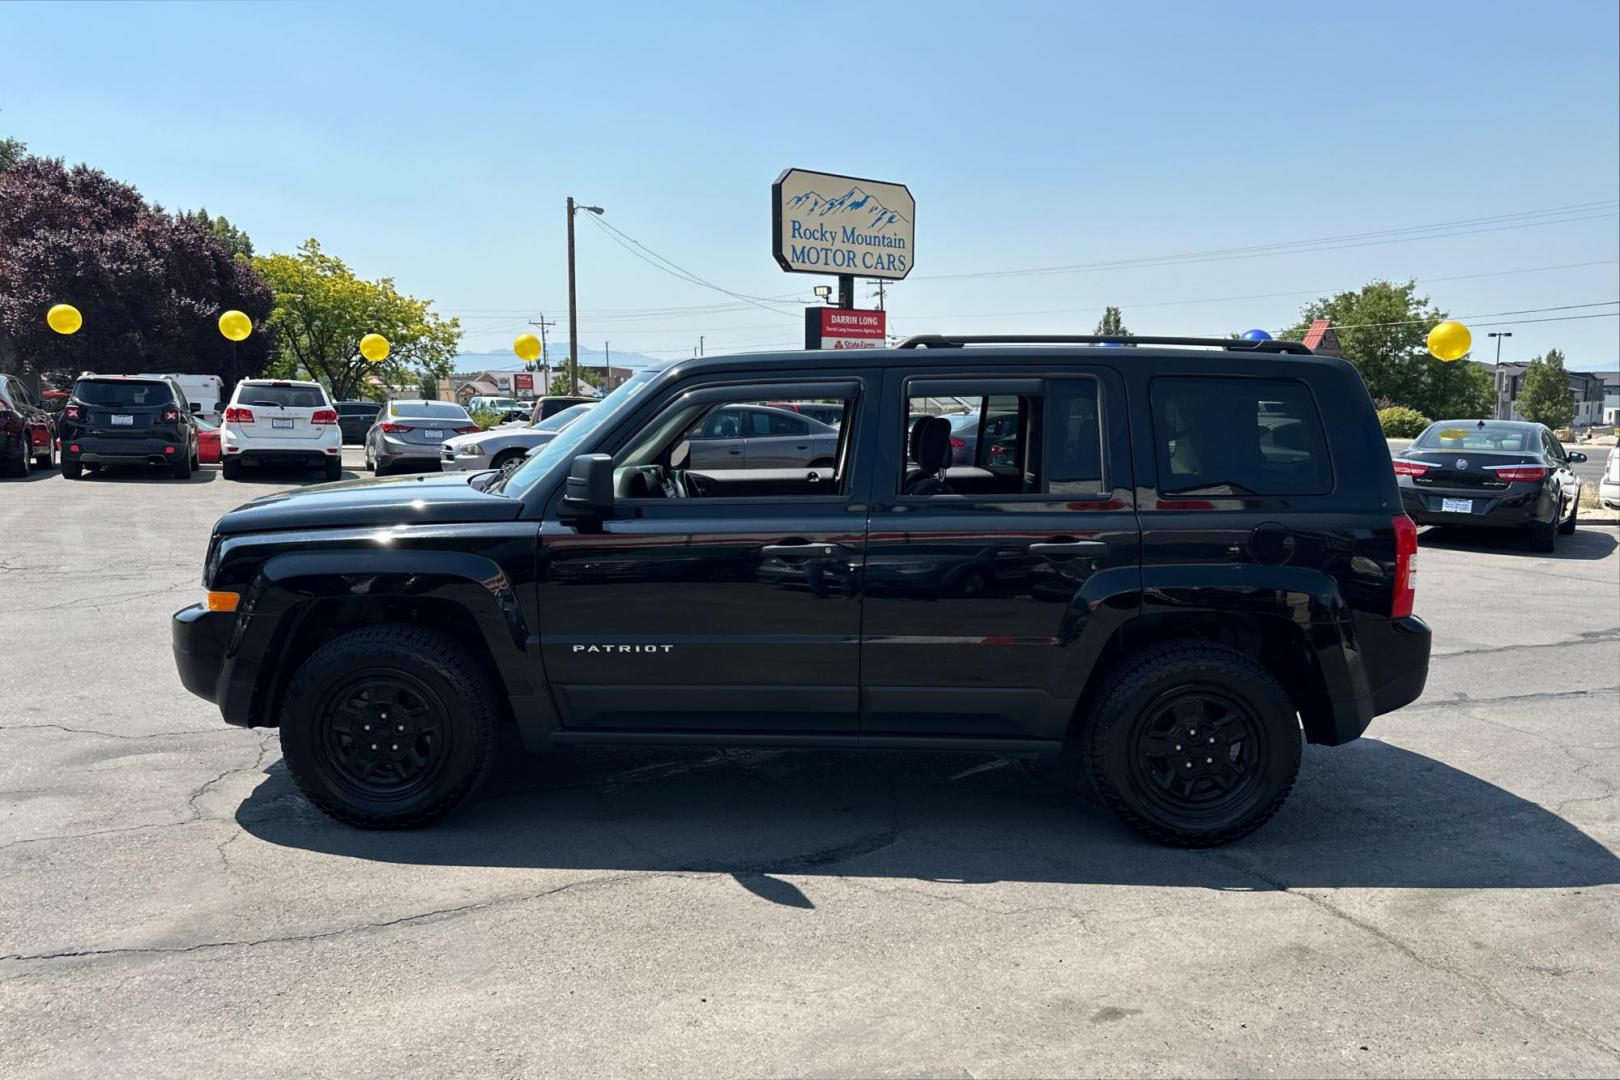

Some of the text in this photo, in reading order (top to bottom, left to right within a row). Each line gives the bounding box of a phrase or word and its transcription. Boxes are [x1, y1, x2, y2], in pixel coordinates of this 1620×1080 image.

[791, 220, 906, 249] Rocky Mountain
[791, 245, 906, 272] MOTOR CARS
[831, 315, 878, 326] DARRIN LONG
[573, 644, 674, 653] PATRIOT
